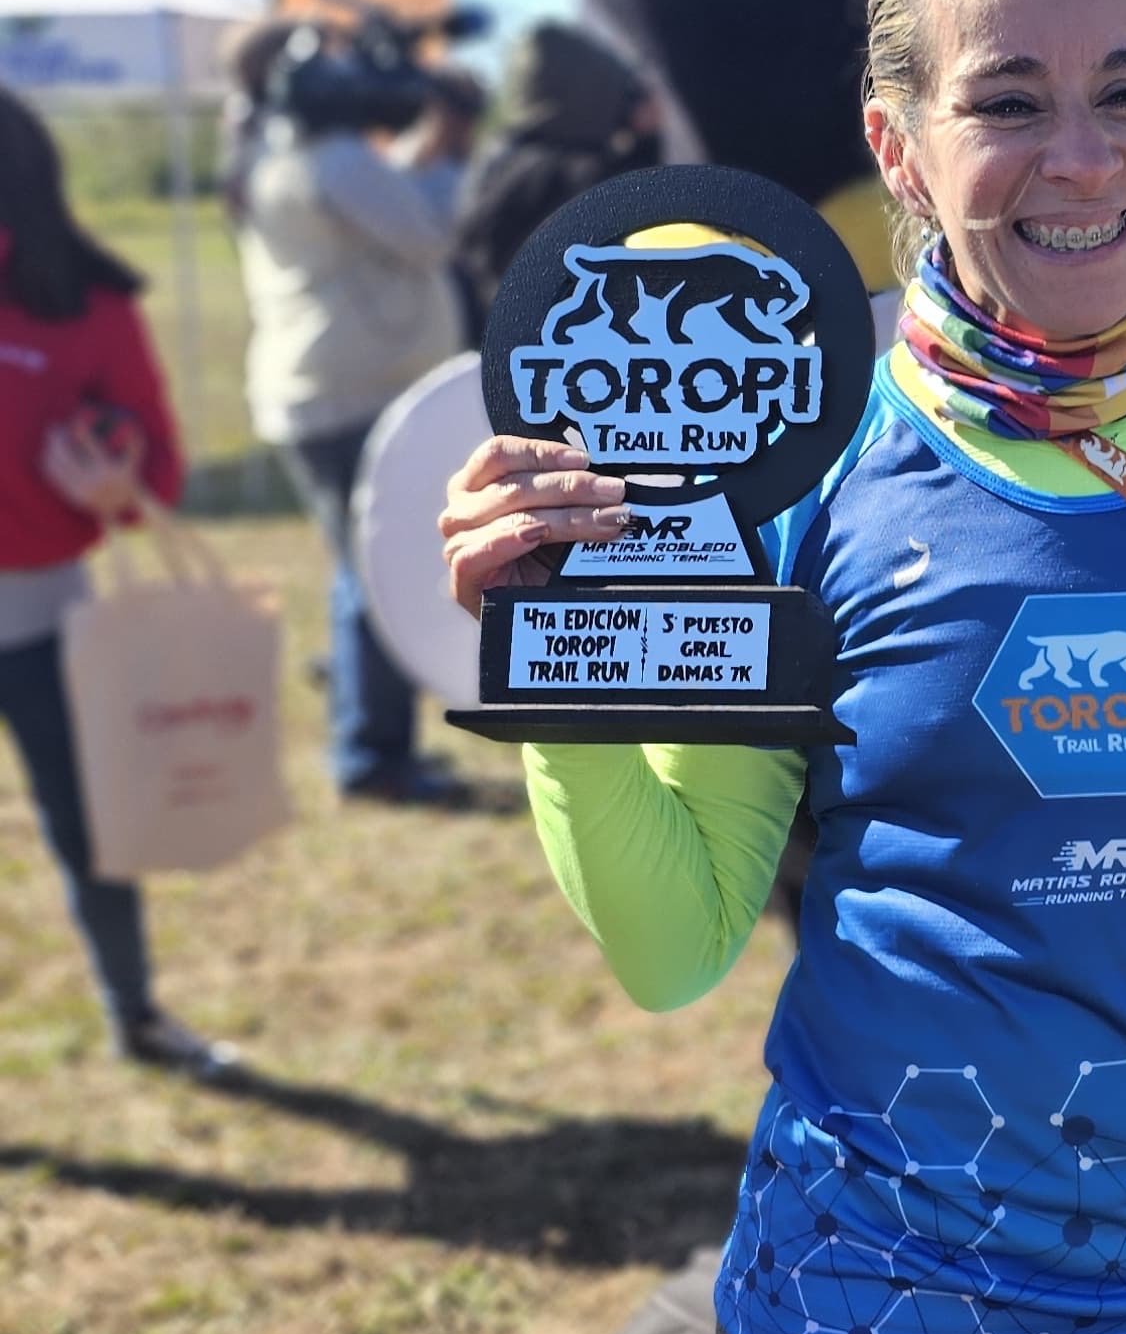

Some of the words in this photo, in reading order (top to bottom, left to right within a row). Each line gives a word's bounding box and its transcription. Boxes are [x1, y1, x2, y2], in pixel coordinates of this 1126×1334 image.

[520, 357, 811, 414] TOROPI
[593, 424, 669, 452] TRAIL
[680, 424, 746, 452] RUN
[629, 515, 692, 540] MR
[581, 542, 646, 553] MATIAS
[653, 542, 737, 553] ROBLEDO
[607, 554, 665, 563] RUNNING
[671, 554, 709, 563] TEAM
[523, 607, 556, 630] 4TA
[564, 604, 642, 631] EDICIÓN
[683, 616, 754, 634] PUESTO
[544, 635, 616, 658] TOROPI
[680, 640, 732, 658] GRAL
[528, 660, 579, 683] TRAIL
[587, 661, 630, 683] RUN
[657, 664, 724, 682] DAMAS
[730, 665, 752, 683] 7K
[1053, 734, 1102, 754] TRAIL
[1011, 874, 1092, 893] MATIAS
[1044, 890, 1114, 905] RUNNING
